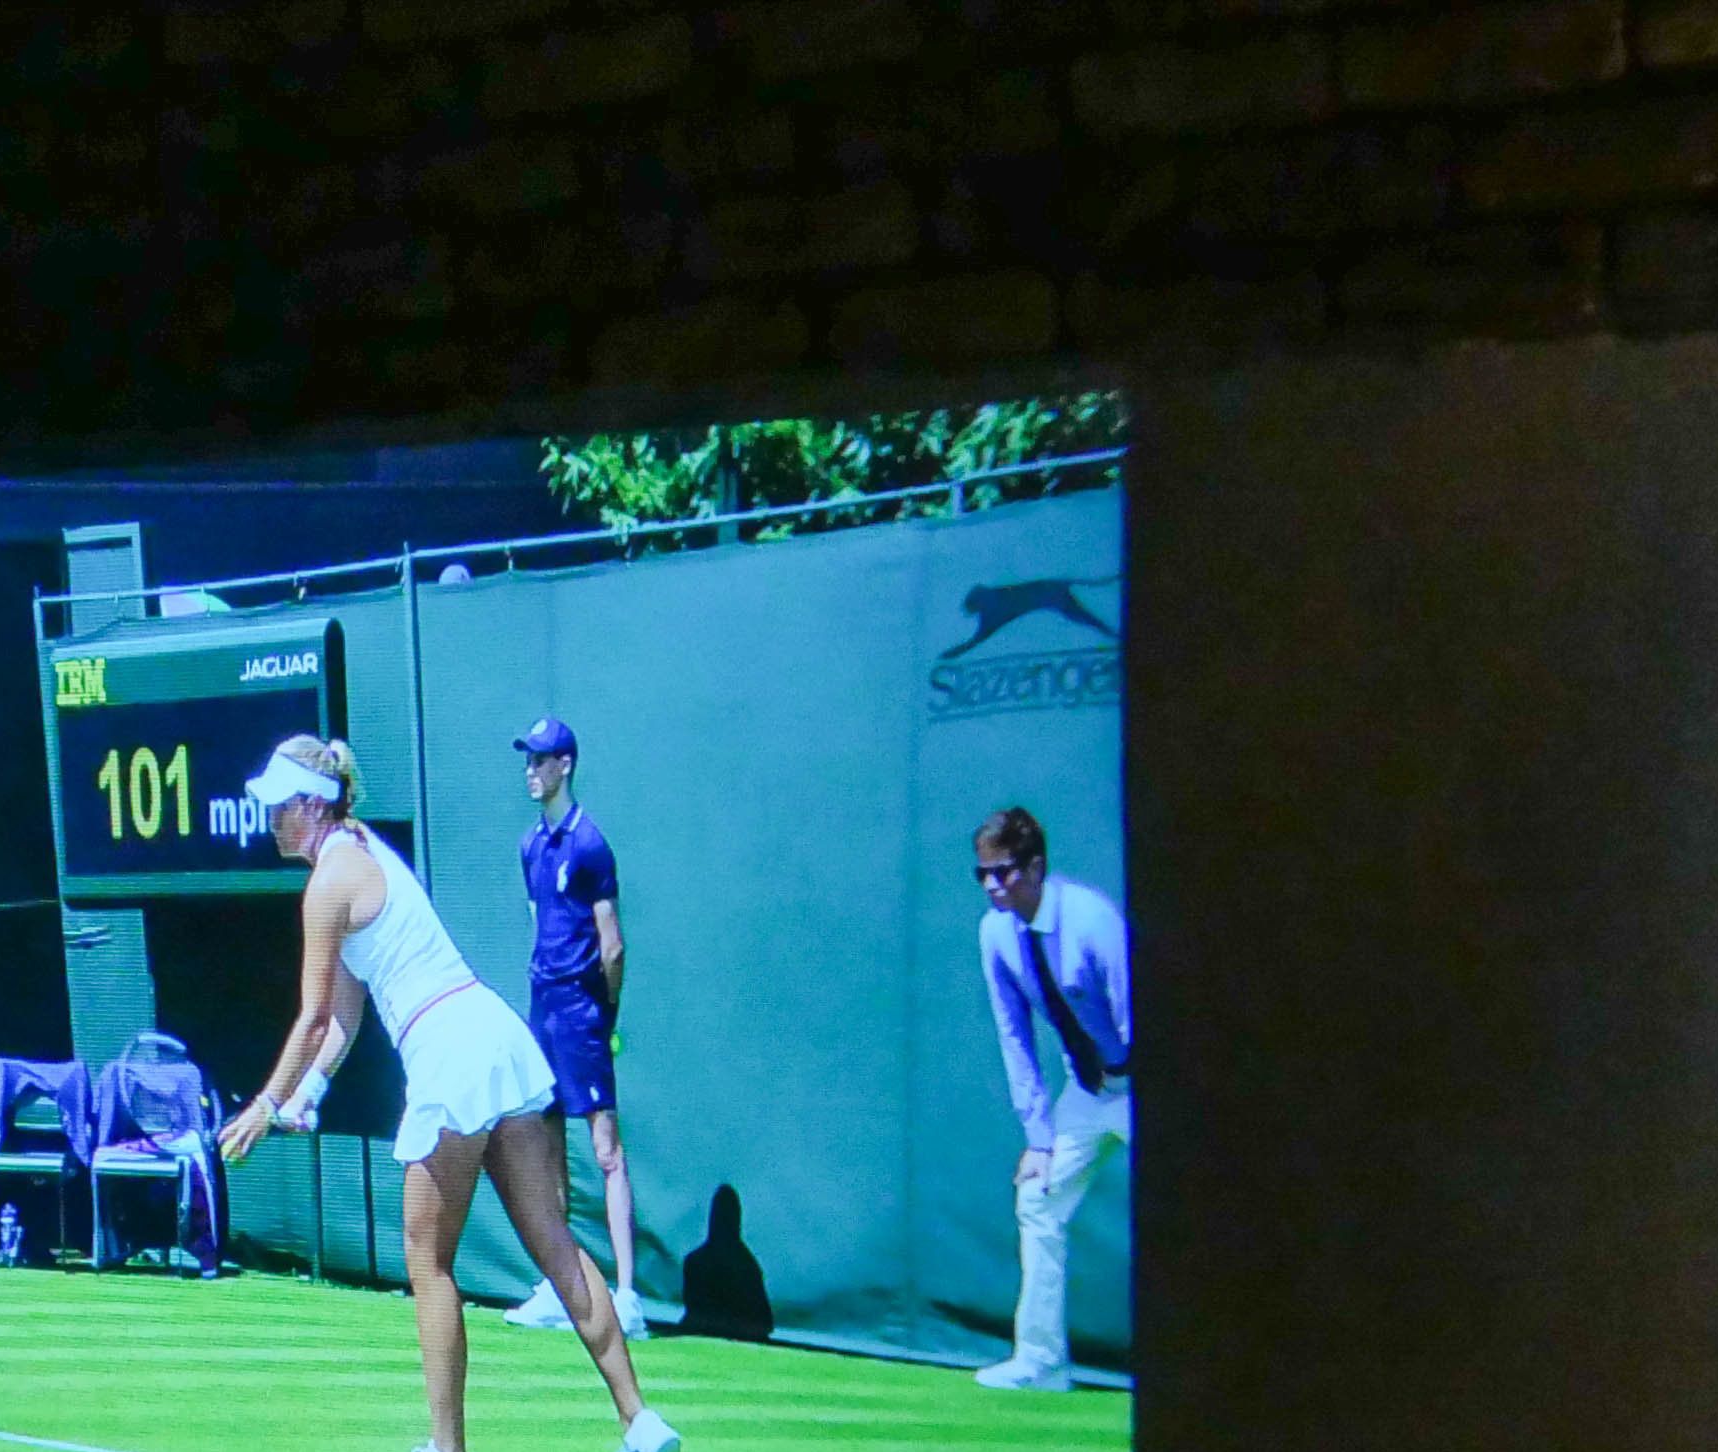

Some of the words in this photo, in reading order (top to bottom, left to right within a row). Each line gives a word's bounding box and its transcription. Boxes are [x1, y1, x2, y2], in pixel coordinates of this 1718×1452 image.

[55, 657, 106, 706] IBM
[240, 652, 318, 681] JAGUAR
[99, 744, 190, 839] 101
